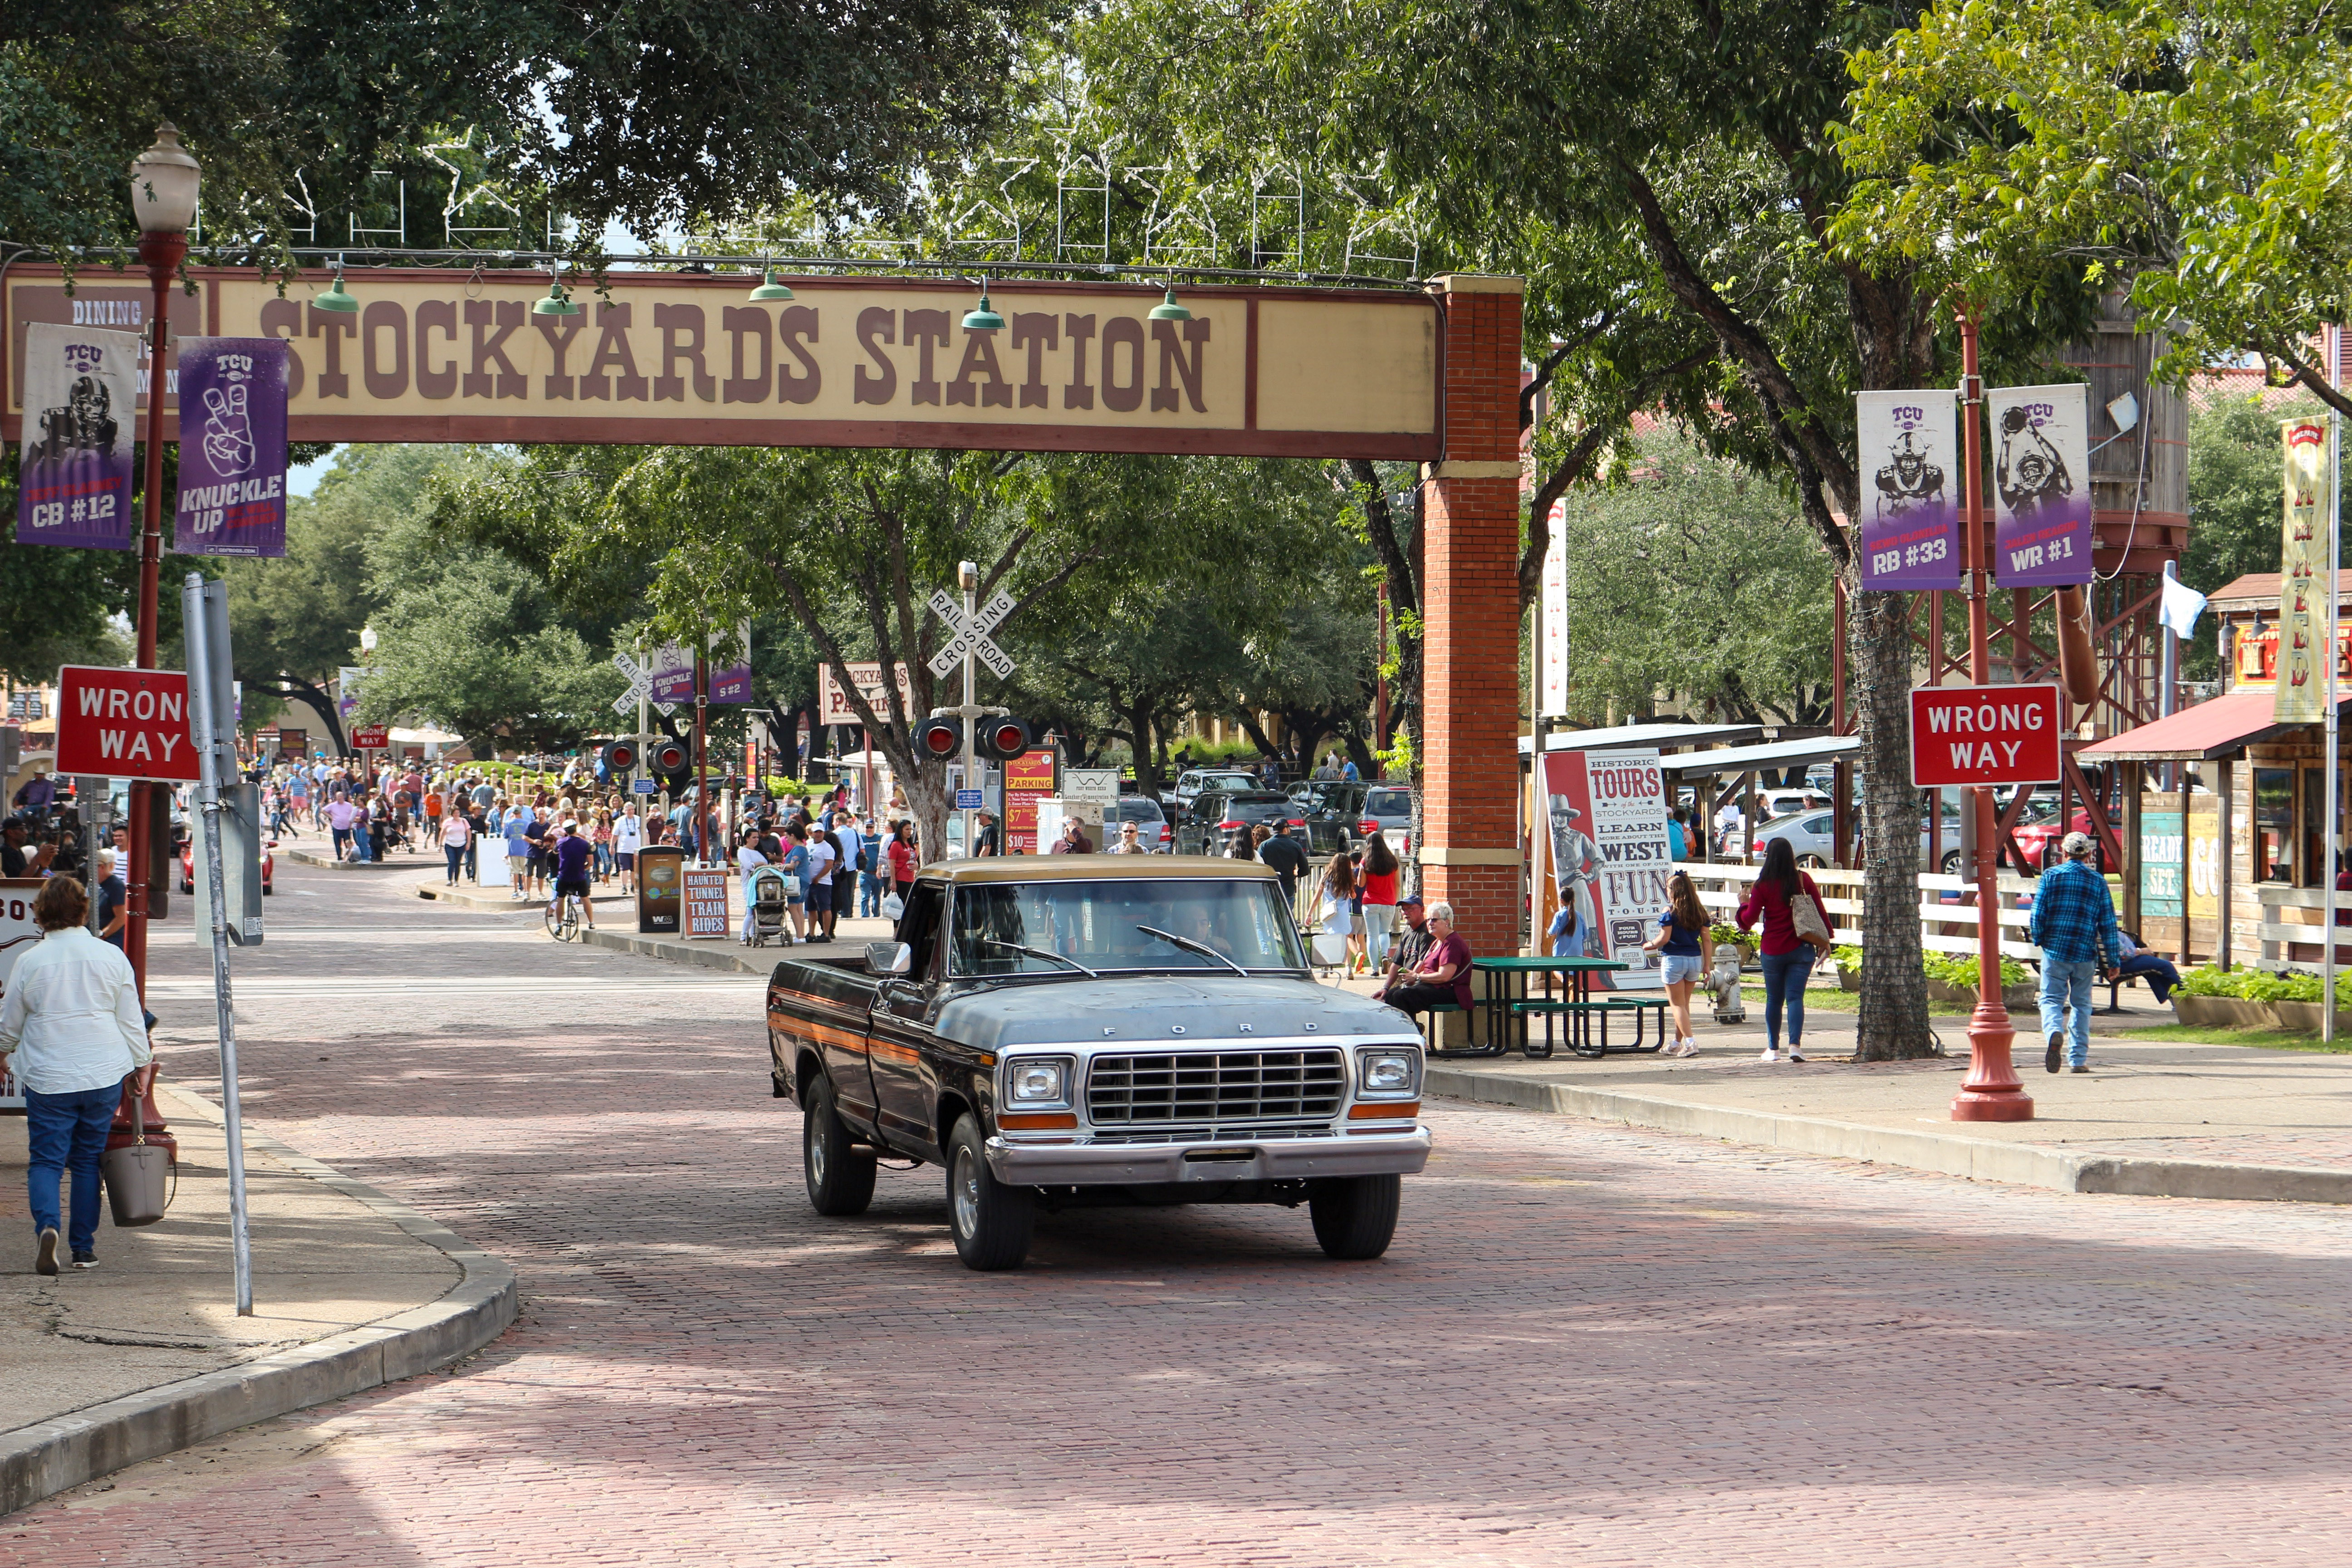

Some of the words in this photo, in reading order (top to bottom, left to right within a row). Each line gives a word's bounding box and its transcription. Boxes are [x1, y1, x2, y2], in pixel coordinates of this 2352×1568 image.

[73, 300, 142, 325] DINING
[65, 344, 103, 363] TCU
[217, 354, 253, 371] TCU
[260, 298, 821, 403] STOCKYARDS
[854, 306, 1210, 412] STATION
[1892, 406, 1923, 421] TCU
[2023, 403, 2054, 418] TCU
[2292, 430, 2319, 443] PREPARE
[26, 486, 60, 501] JEFF
[62, 476, 123, 496] GLADNEY
[181, 475, 282, 512] KNUCKLE
[32, 502, 65, 528] CB
[70, 494, 116, 522] #12
[193, 509, 224, 534] UP
[1869, 536, 1898, 551] SEWO
[2004, 532, 2036, 550] JALEN
[1873, 549, 1901, 576] RB
[1906, 538, 1947, 568] #33
[2010, 545, 2044, 572] WR
[2048, 536, 2073, 562] #1
[932, 594, 962, 629] RAIL
[976, 640, 1010, 675] ROAD
[936, 598, 1009, 671] CROSSING
[616, 655, 638, 680] RAIL
[655, 671, 692, 688] KNUCKLE
[660, 686, 671, 696] UP
[720, 688, 726, 697] S
[728, 684, 741, 695] #2
[79, 686, 190, 722] WRON
[1928, 703, 2043, 733] WRONG
[100, 729, 181, 762] WAY
[1950, 740, 2023, 769] WAY
[1591, 759, 1655, 768] HISTORIC
[1008, 778, 1052, 788] PARKING
[1590, 767, 1661, 799] TOURS
[1595, 808, 1662, 817] STOCKYARDS
[1621, 801, 1627, 809] of
[1009, 808, 1021, 823] $7
[1598, 823, 1663, 833] LEARN
[1008, 834, 1023, 848] $10
[2141, 835, 2183, 862] READY
[1600, 841, 1666, 862] WEST
[687, 875, 724, 886] HAUNTED
[1604, 868, 1670, 906] FUN
[687, 887, 725, 900] TUNNEL
[688, 901, 726, 916] TRAIN
[692, 917, 725, 932] RIDES
[1103, 1022, 1318, 1036] FORD
